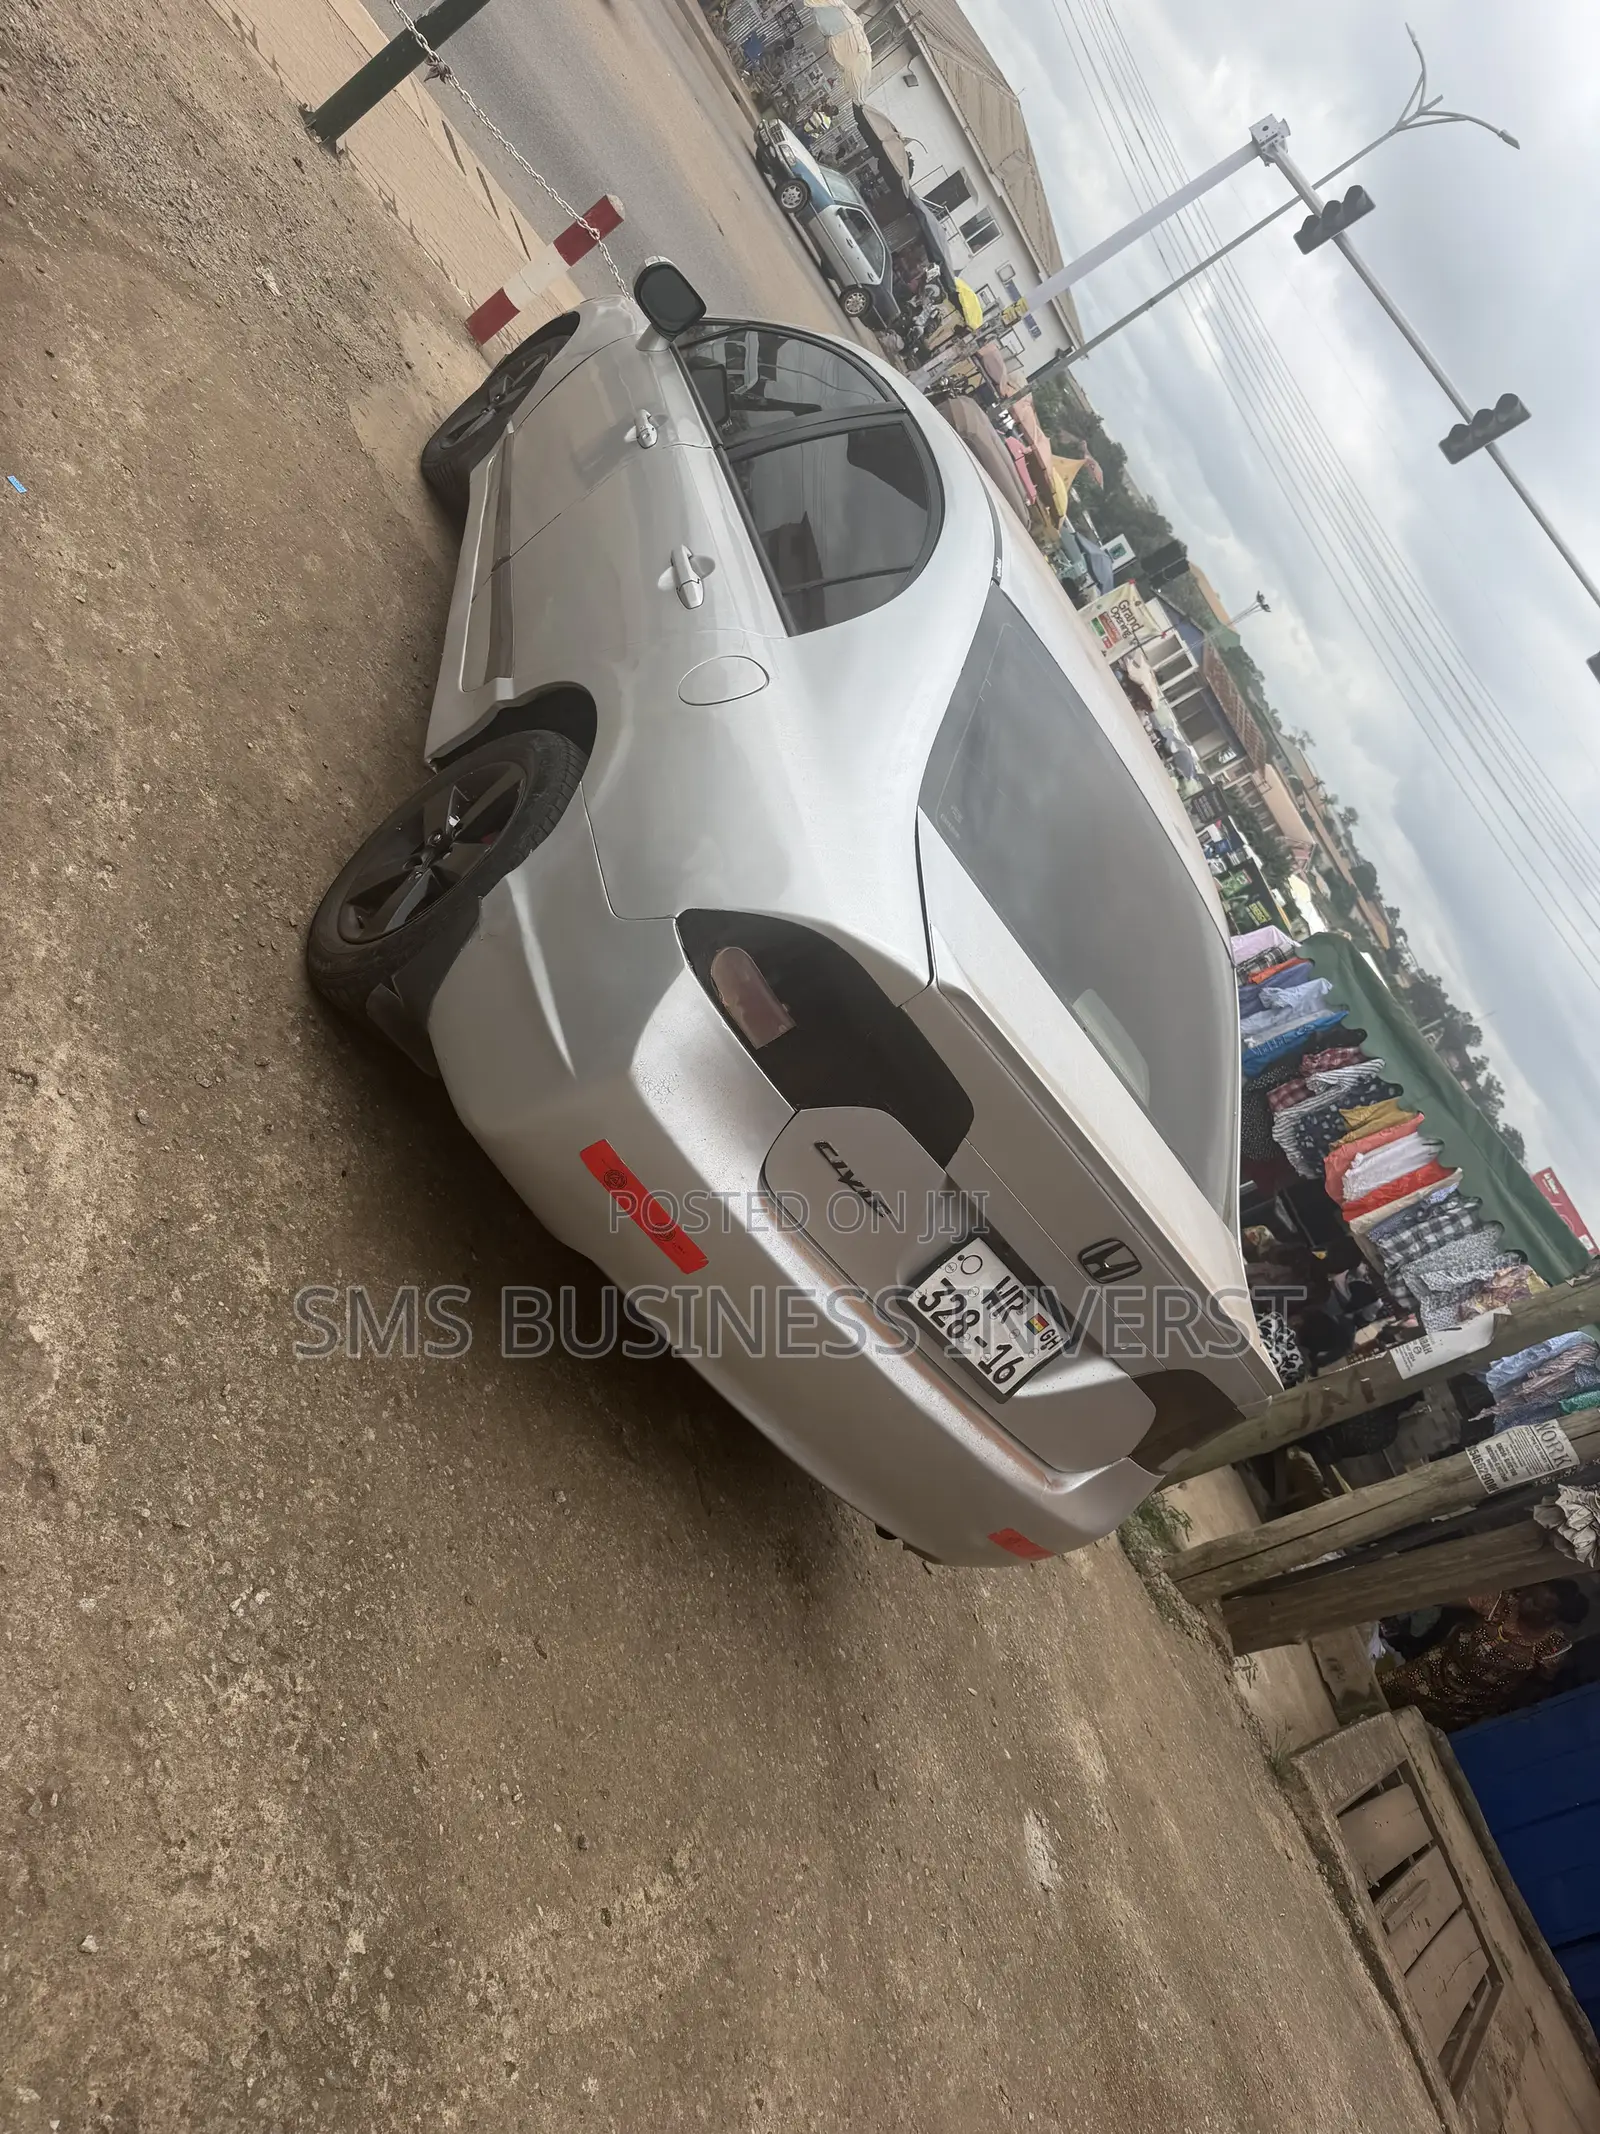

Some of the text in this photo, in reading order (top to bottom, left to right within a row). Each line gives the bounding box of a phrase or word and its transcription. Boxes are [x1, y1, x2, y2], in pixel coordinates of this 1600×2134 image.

[1110, 606, 1132, 639] Opening
[1118, 600, 1144, 633] Grand
[981, 1275, 1064, 1351] WR GH
